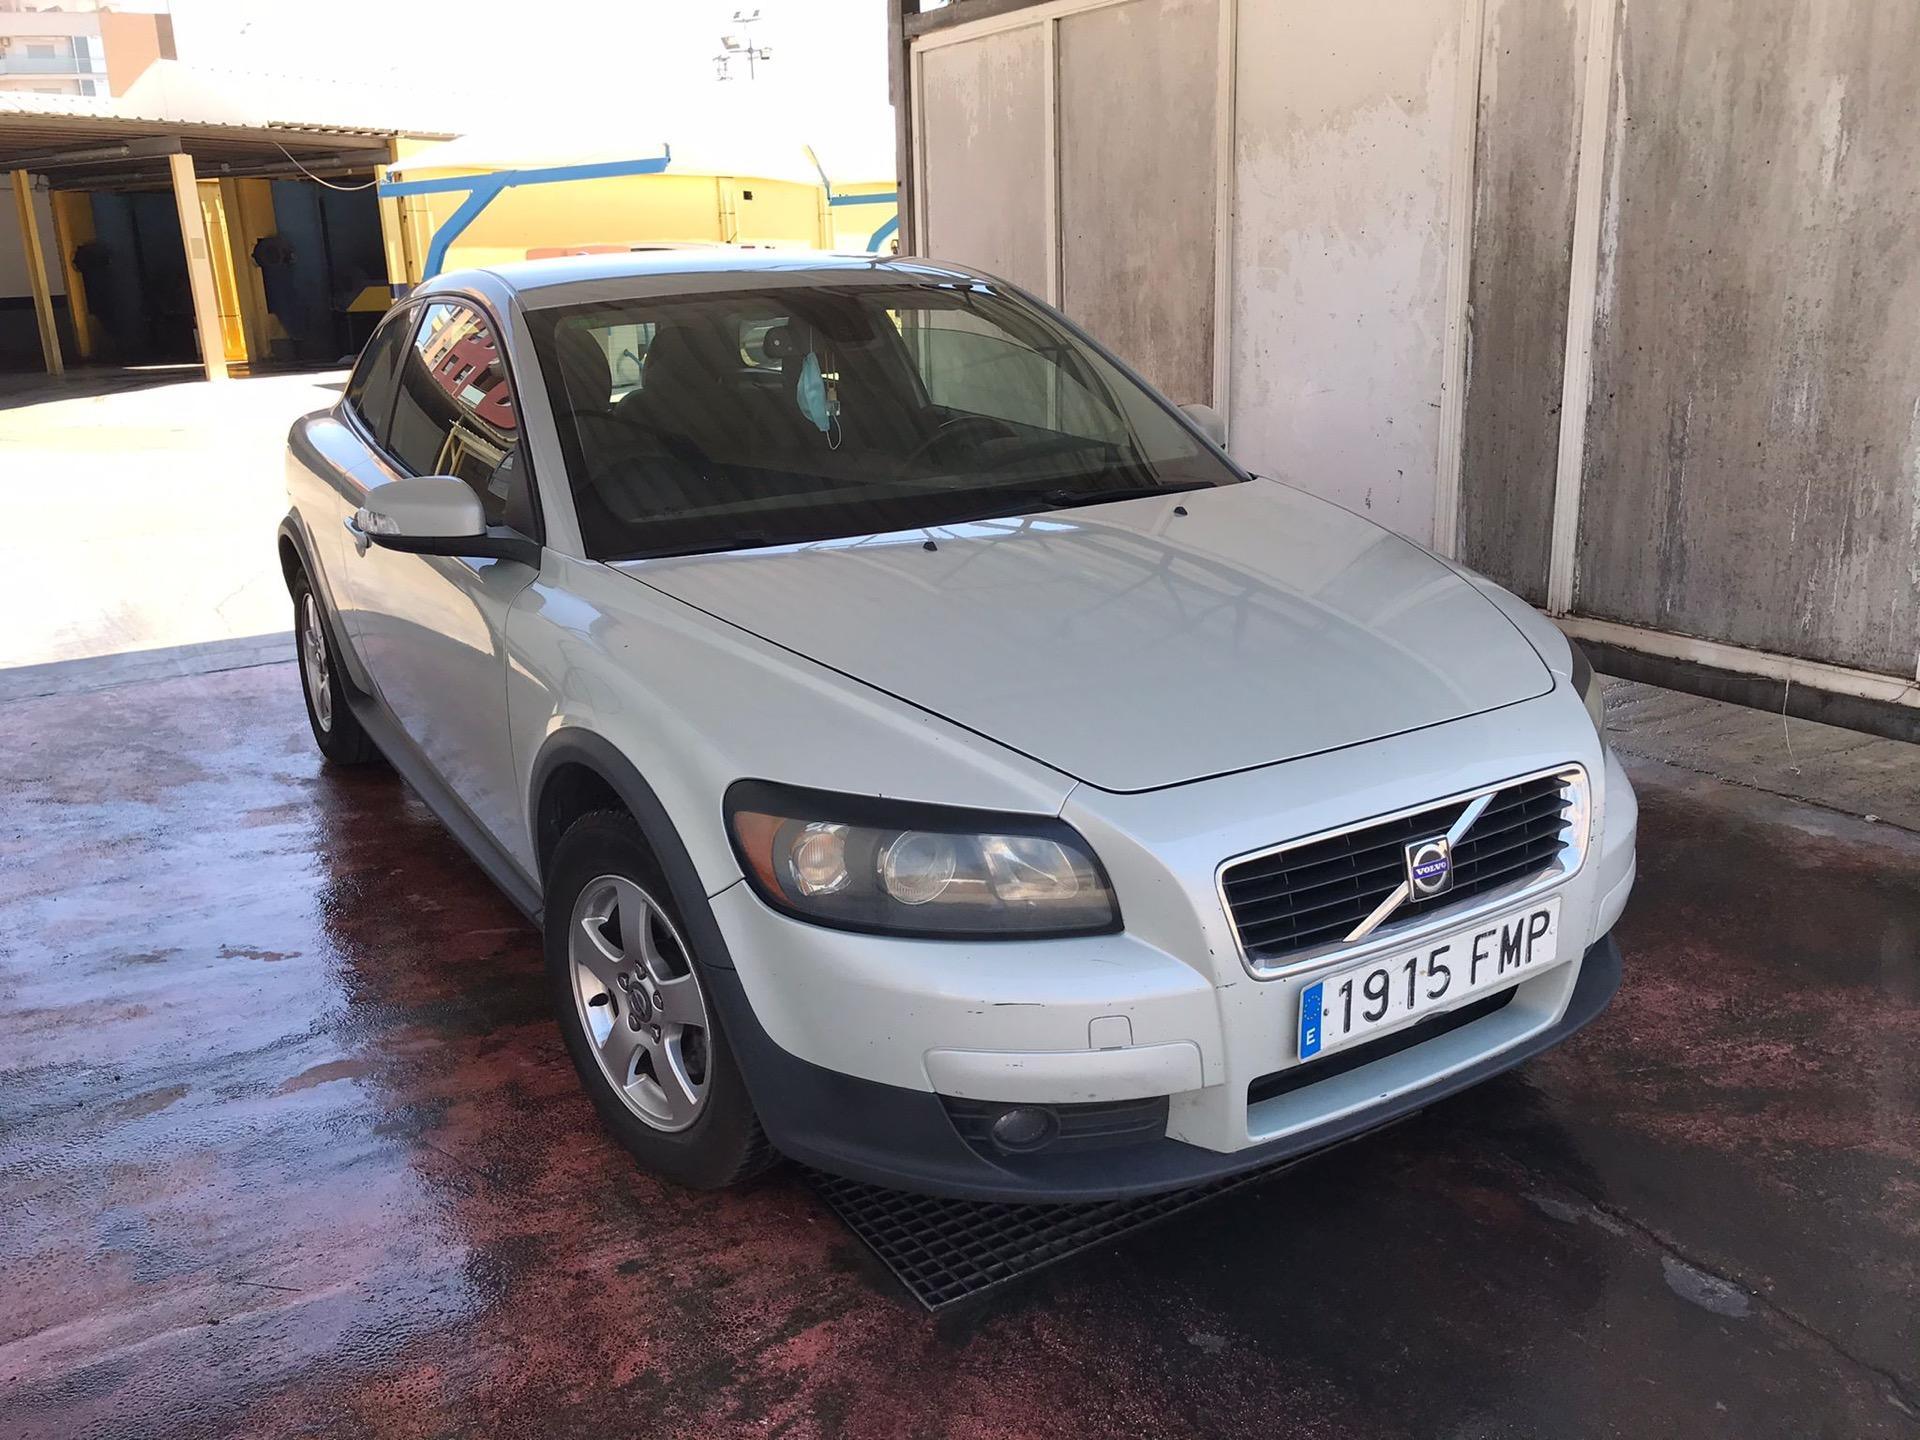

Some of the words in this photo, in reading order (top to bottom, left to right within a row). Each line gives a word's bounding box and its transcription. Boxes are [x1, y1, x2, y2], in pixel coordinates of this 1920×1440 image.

[1415, 861, 1447, 876] VOLVO
[1339, 945, 1451, 1034] 1915
[1470, 910, 1551, 985] FMP
[1306, 1027, 1316, 1046] E
